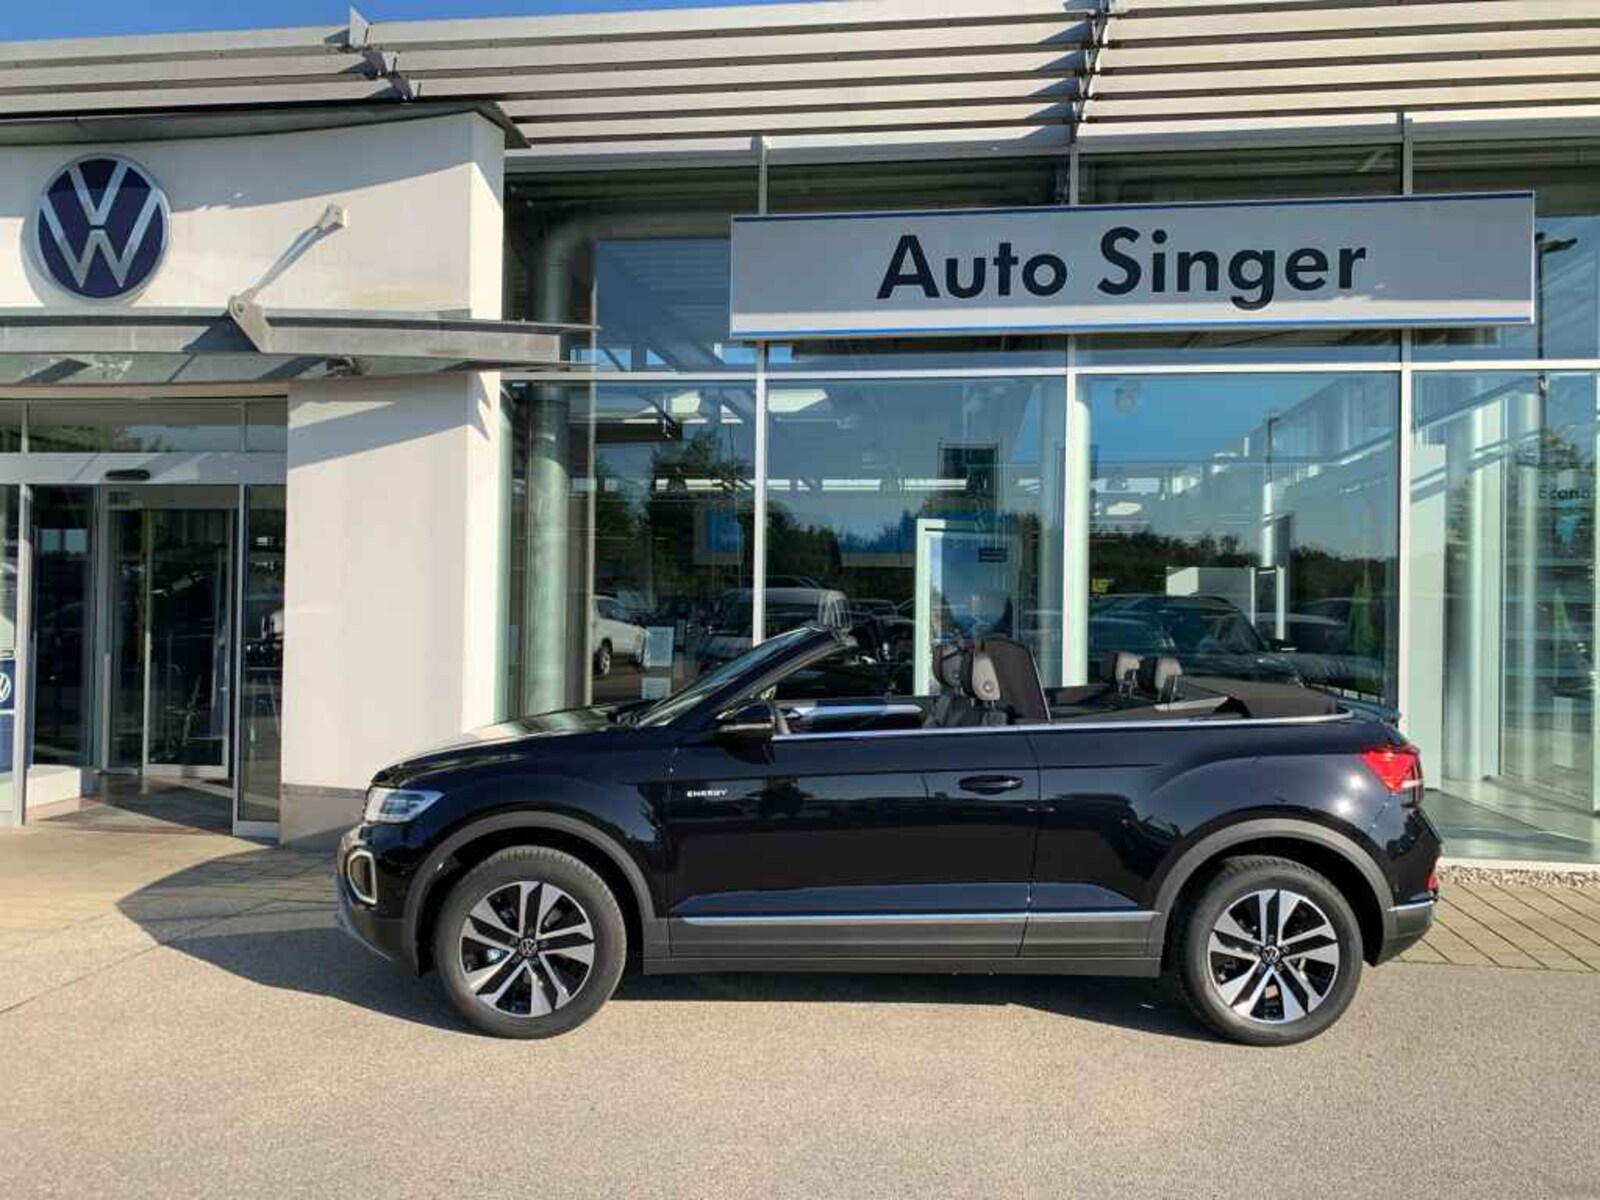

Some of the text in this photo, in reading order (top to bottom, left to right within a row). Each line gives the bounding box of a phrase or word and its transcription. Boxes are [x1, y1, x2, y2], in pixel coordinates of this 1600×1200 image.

[38, 158, 163, 290] VW
[877, 226, 1367, 311] Auto Singer
